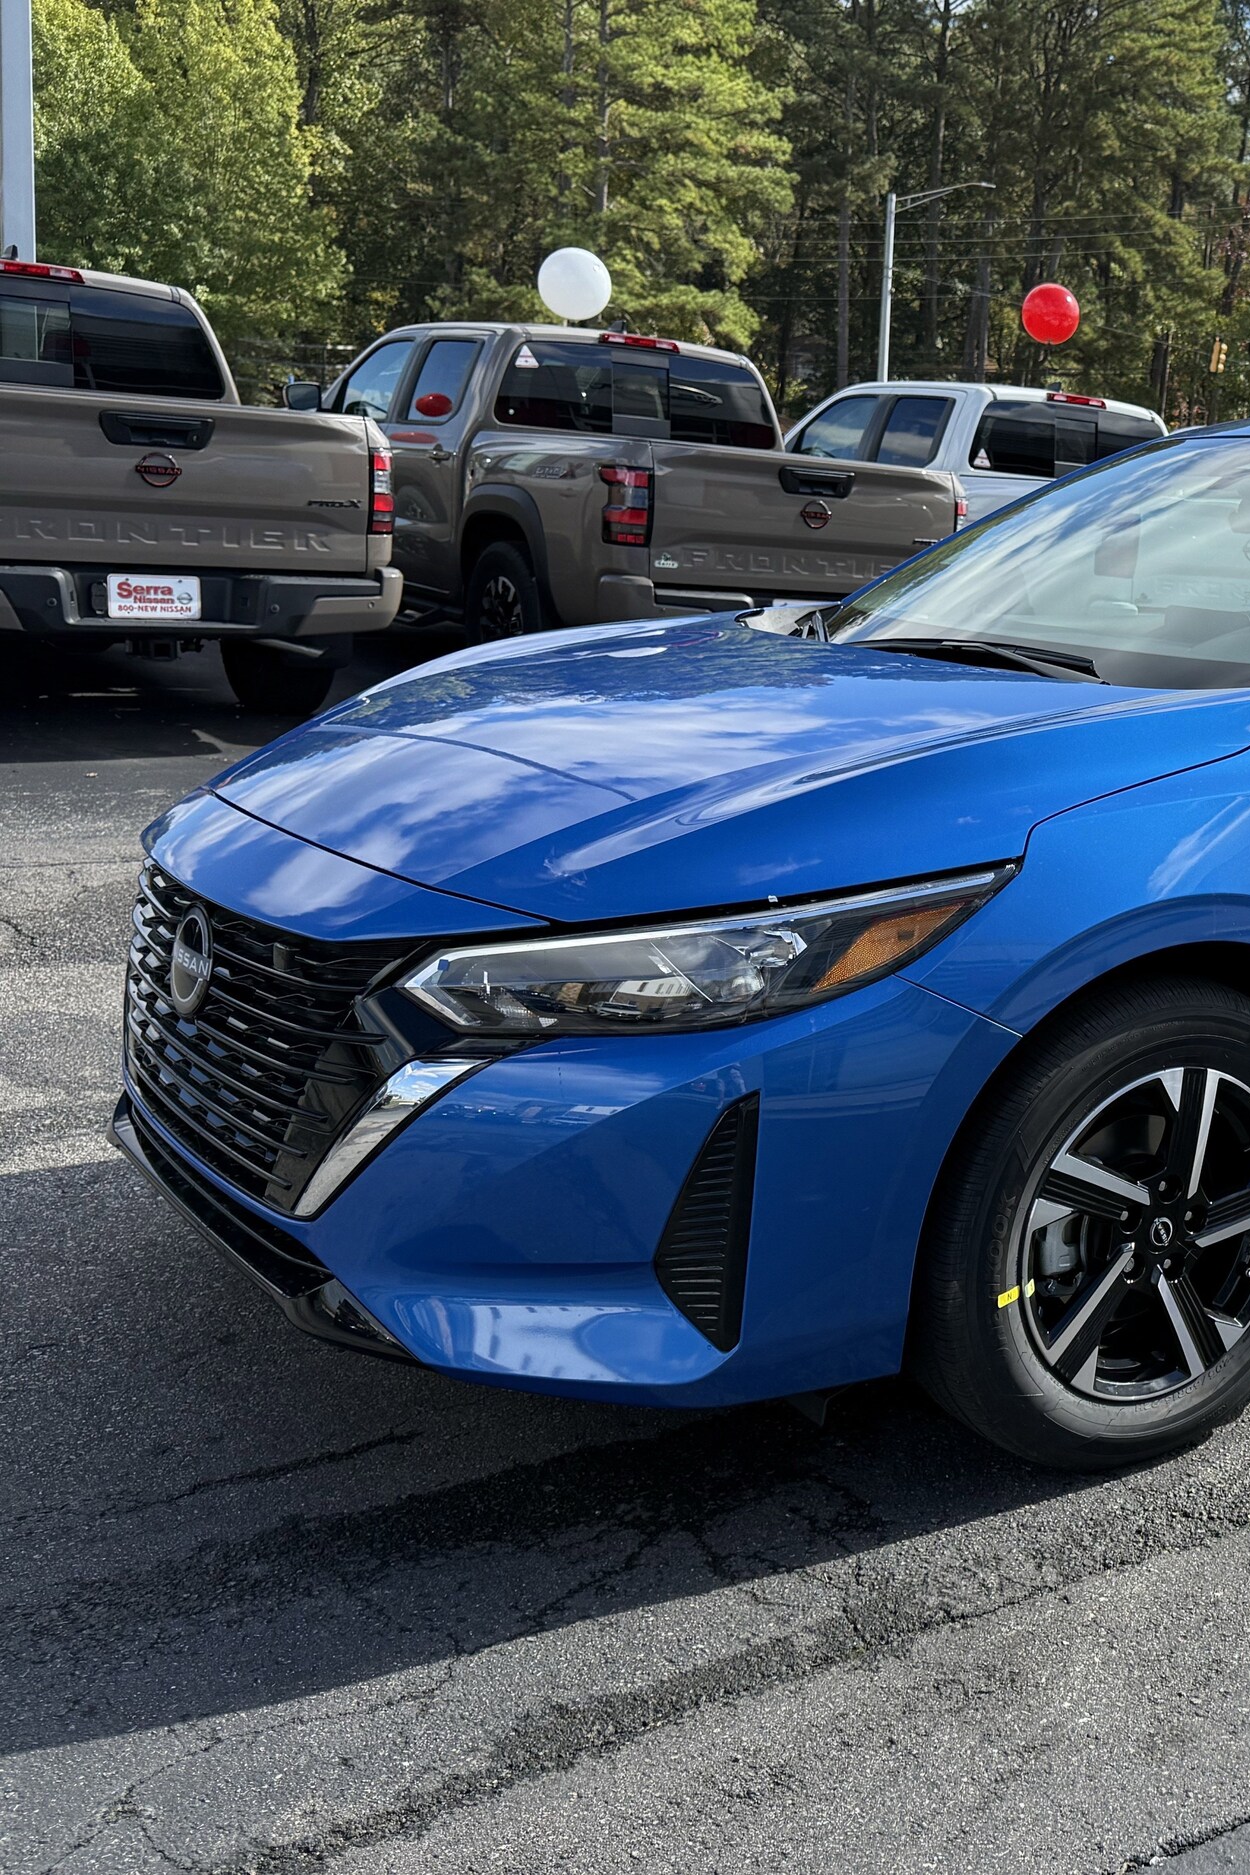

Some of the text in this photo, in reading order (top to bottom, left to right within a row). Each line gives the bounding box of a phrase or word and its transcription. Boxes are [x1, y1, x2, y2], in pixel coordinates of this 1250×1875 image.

[136, 465, 182, 476] NISSAN
[0, 512, 331, 552] RONTIER
[116, 581, 174, 598] Serra
[133, 595, 175, 605] Nissan
[117, 604, 192, 614] 800-NEW NISSAN
